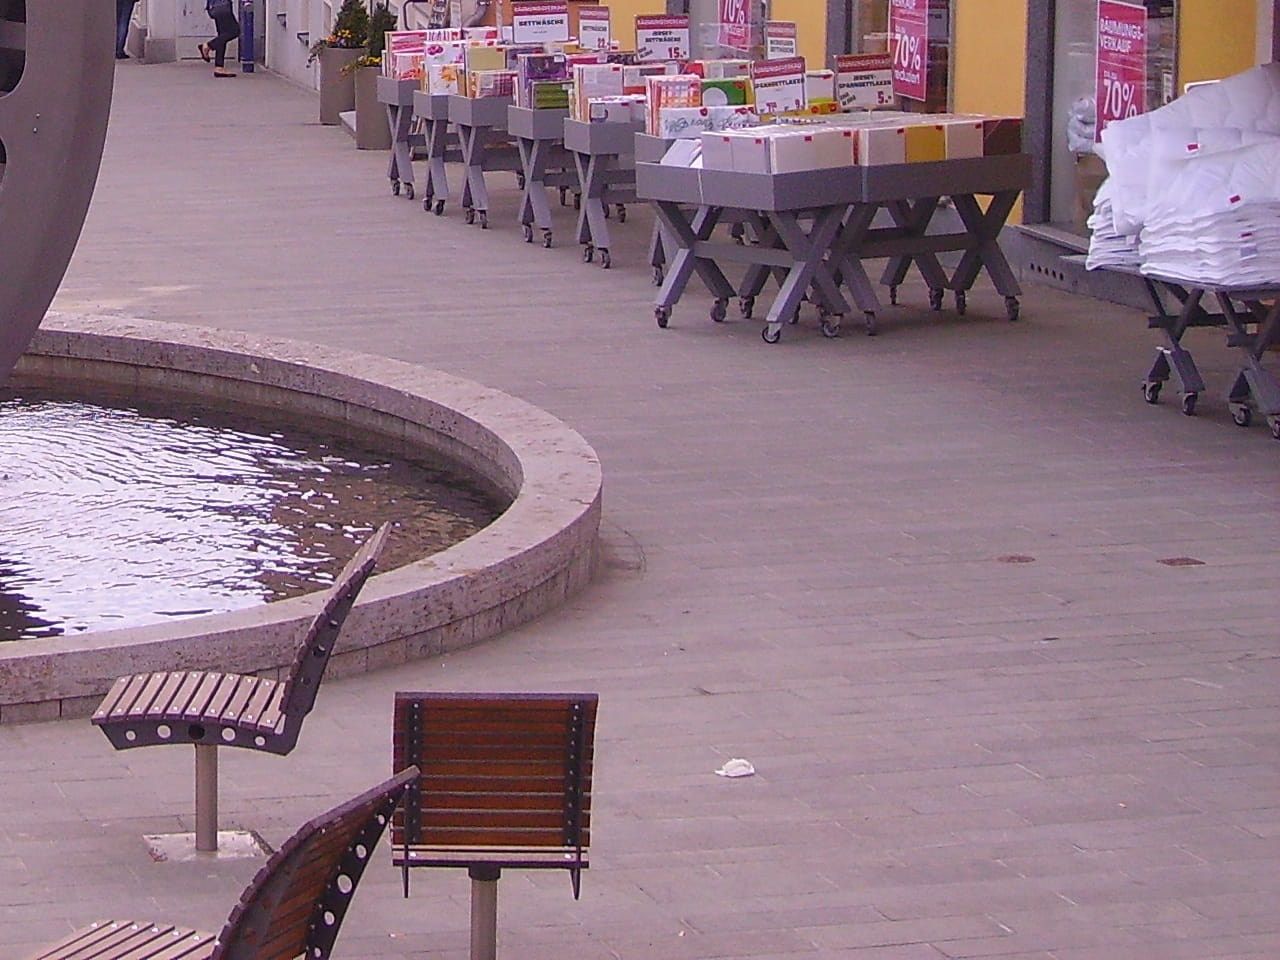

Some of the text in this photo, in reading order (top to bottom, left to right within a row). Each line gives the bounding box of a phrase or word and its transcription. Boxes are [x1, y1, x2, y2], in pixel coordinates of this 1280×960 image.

[1100, 16, 1144, 40] RÄUMUNGS-
[1100, 34, 1132, 53] VERKAUF
[894, 32, 921, 71] 70%
[1104, 78, 1138, 120] 70%
